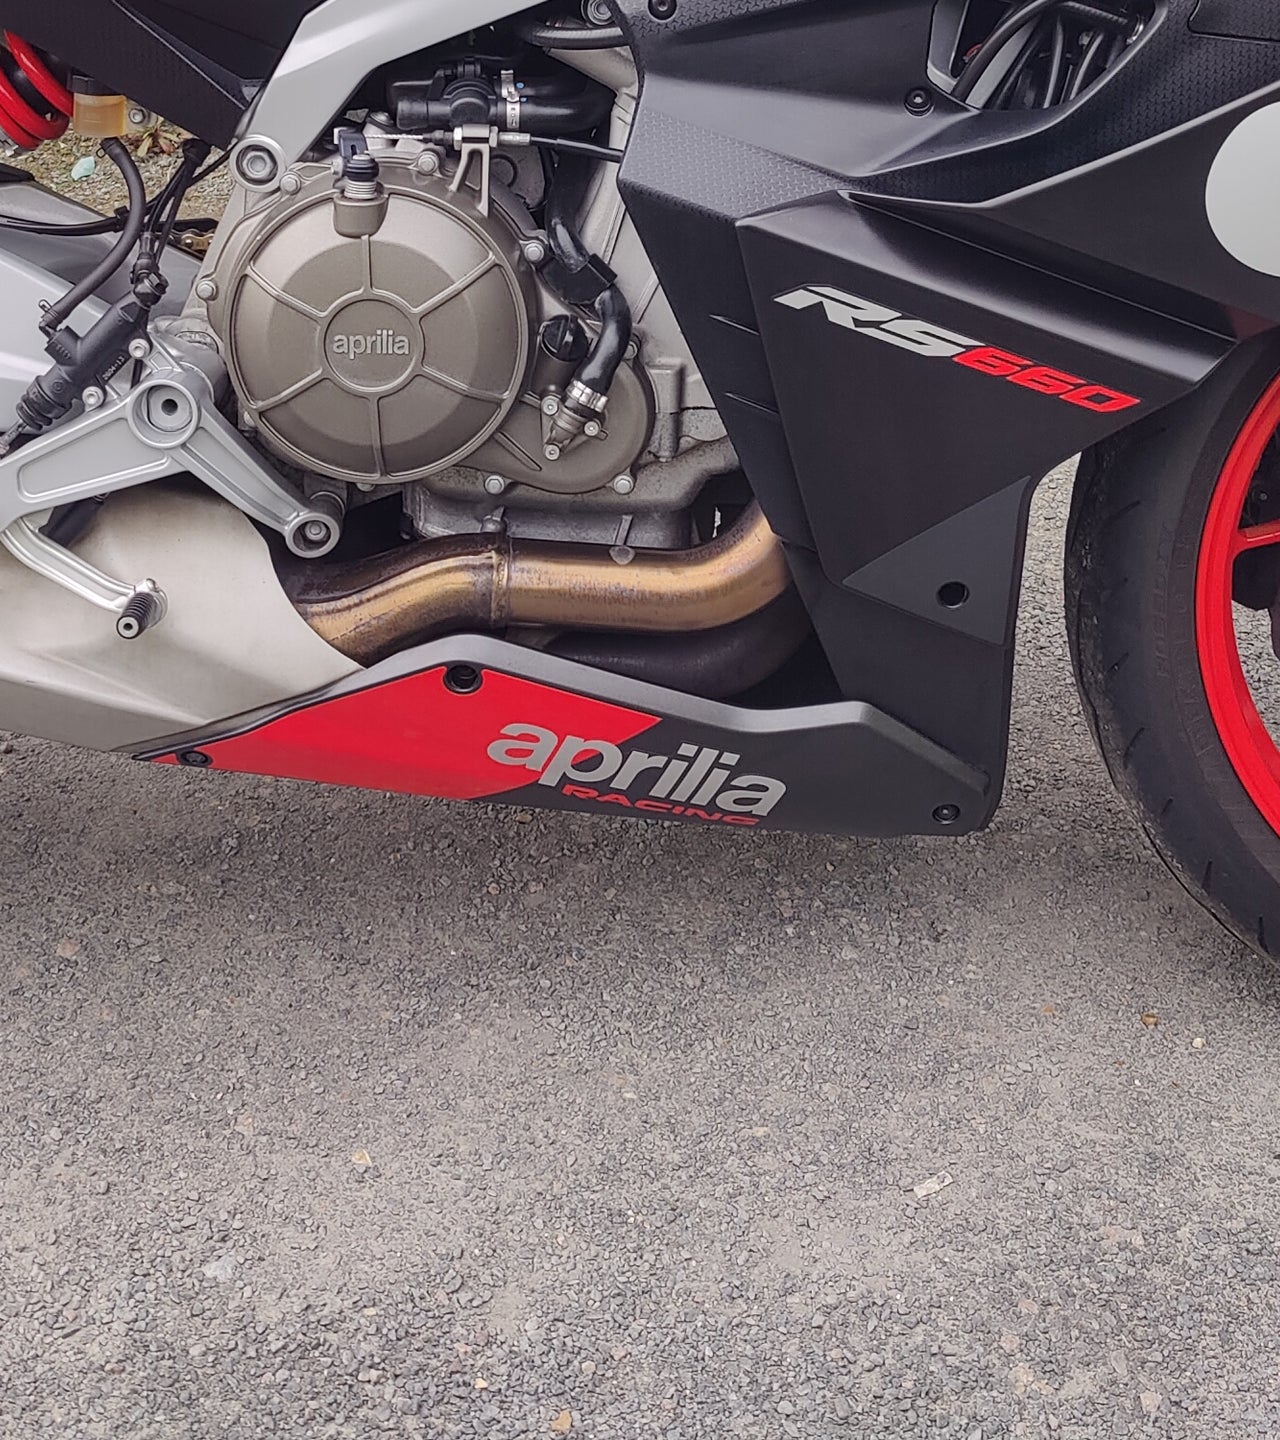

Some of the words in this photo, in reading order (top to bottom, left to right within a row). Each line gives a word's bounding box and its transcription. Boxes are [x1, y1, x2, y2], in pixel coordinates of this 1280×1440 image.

[332, 329, 409, 360] aprilia
[487, 723, 786, 817] aprilia
[561, 784, 760, 826] RACING
